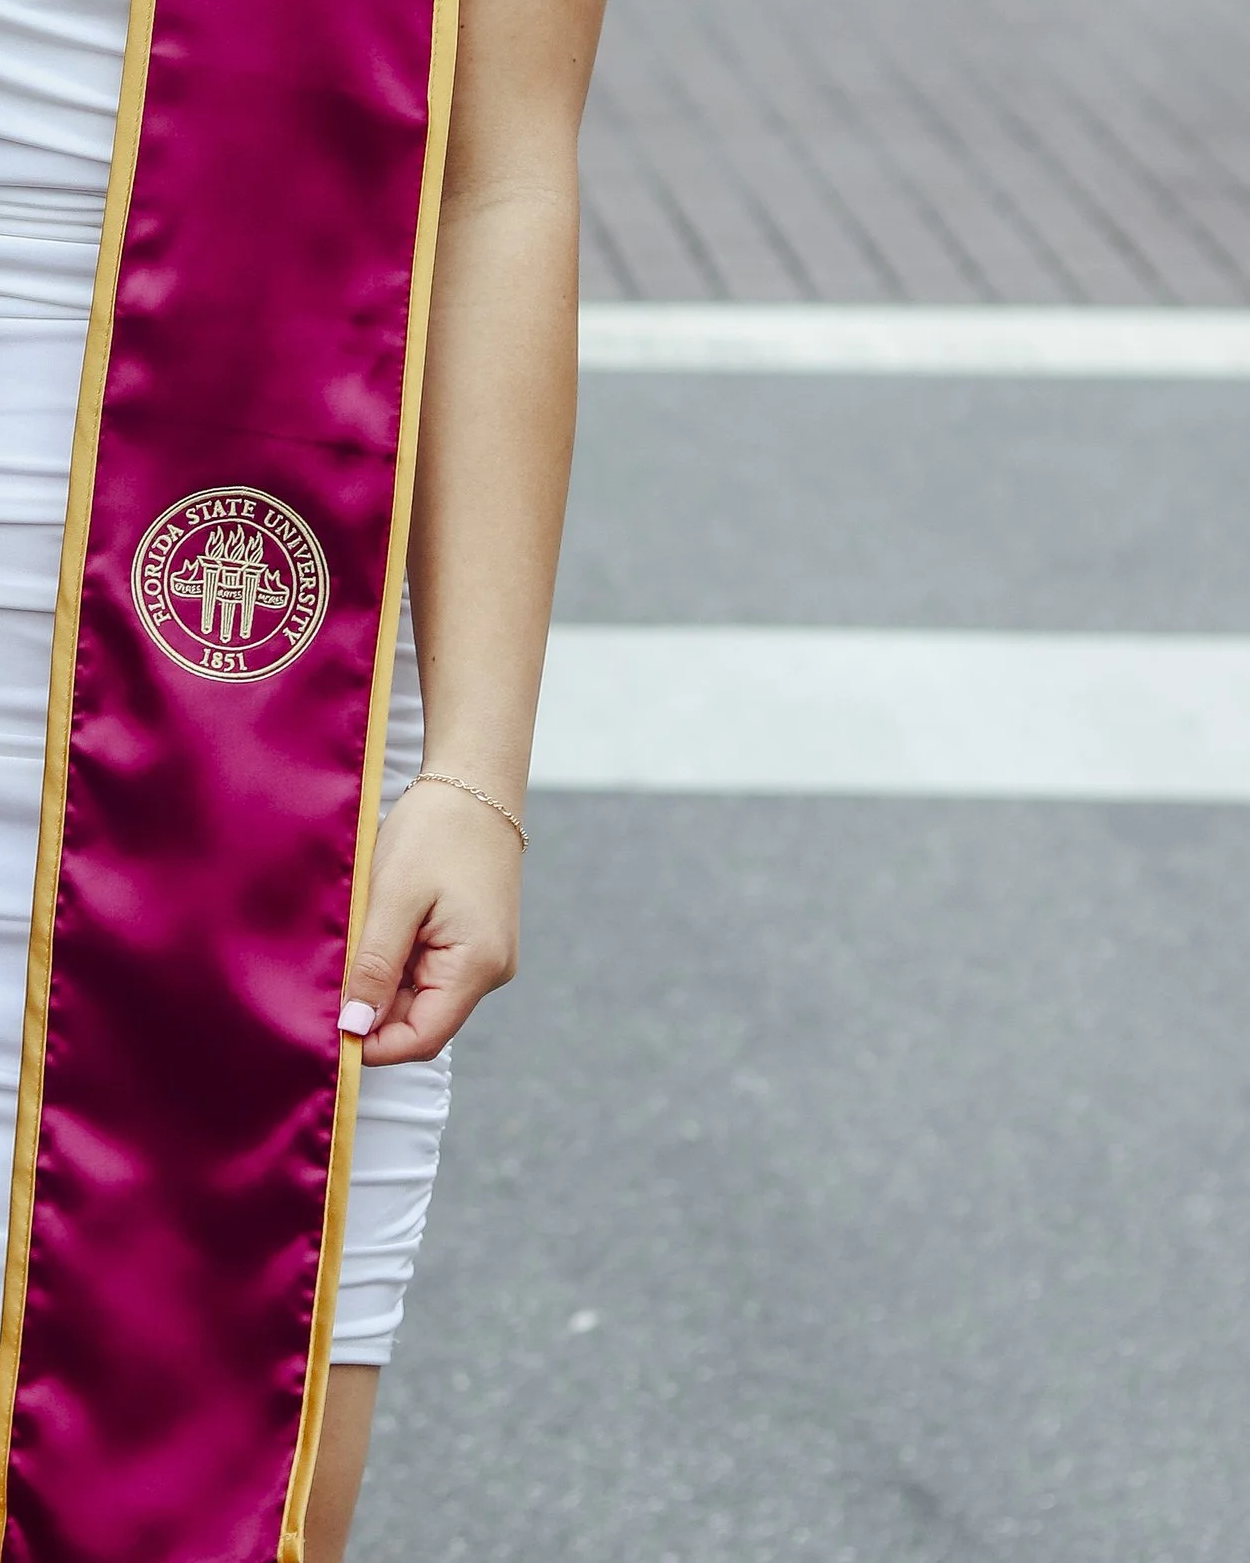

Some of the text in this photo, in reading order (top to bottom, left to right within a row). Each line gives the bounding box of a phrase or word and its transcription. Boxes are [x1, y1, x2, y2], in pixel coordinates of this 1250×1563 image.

[144, 498, 317, 645] FLORIDA STATE UNIVERSITY
[199, 648, 248, 672] 1851
